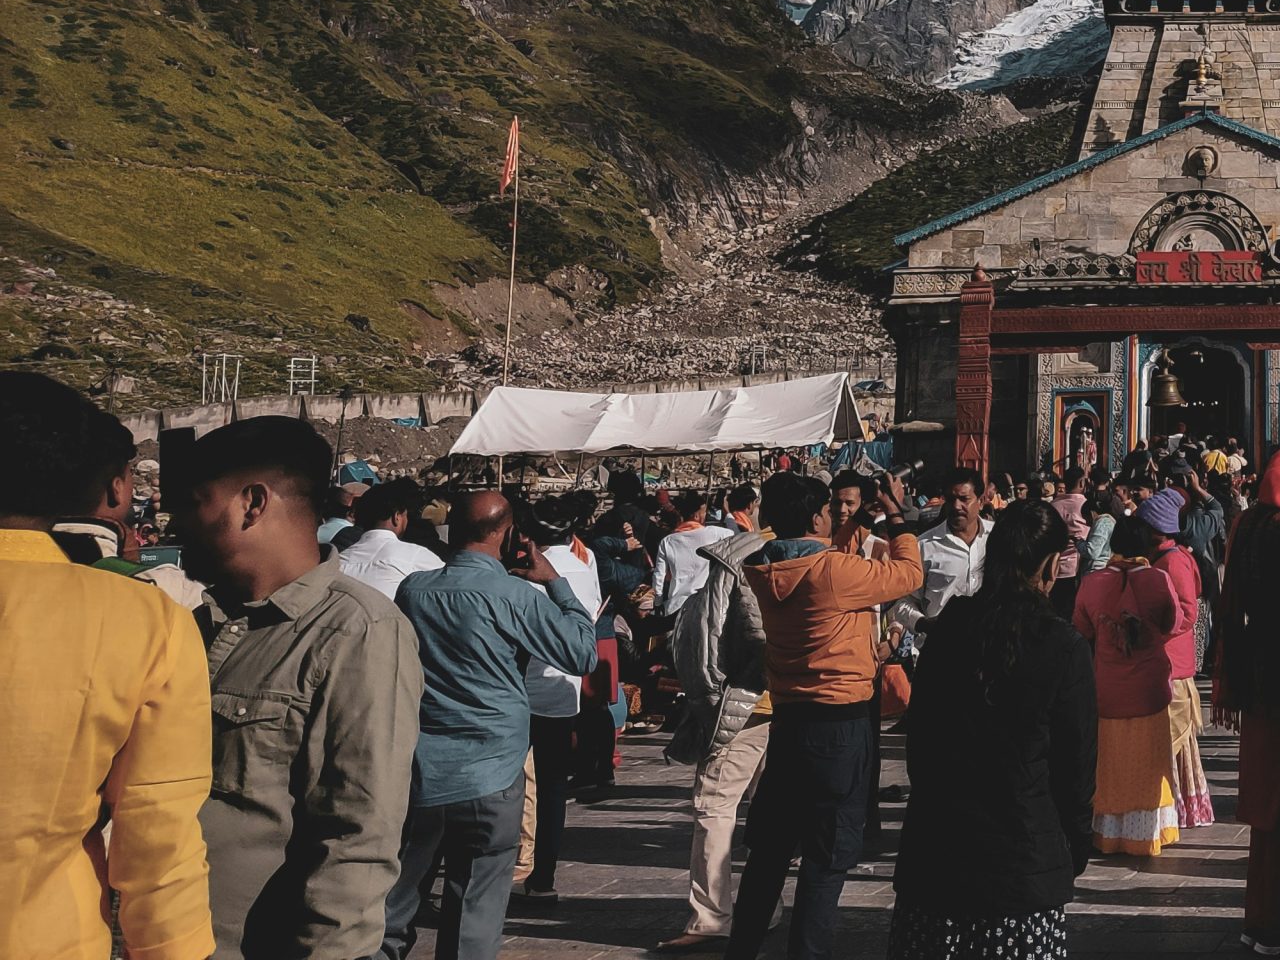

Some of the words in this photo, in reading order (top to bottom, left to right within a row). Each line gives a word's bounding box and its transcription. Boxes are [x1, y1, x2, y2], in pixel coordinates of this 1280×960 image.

[1138, 261, 1169, 281] जय
[1179, 252, 1201, 281] श्री
[1212, 252, 1258, 281] केदार
